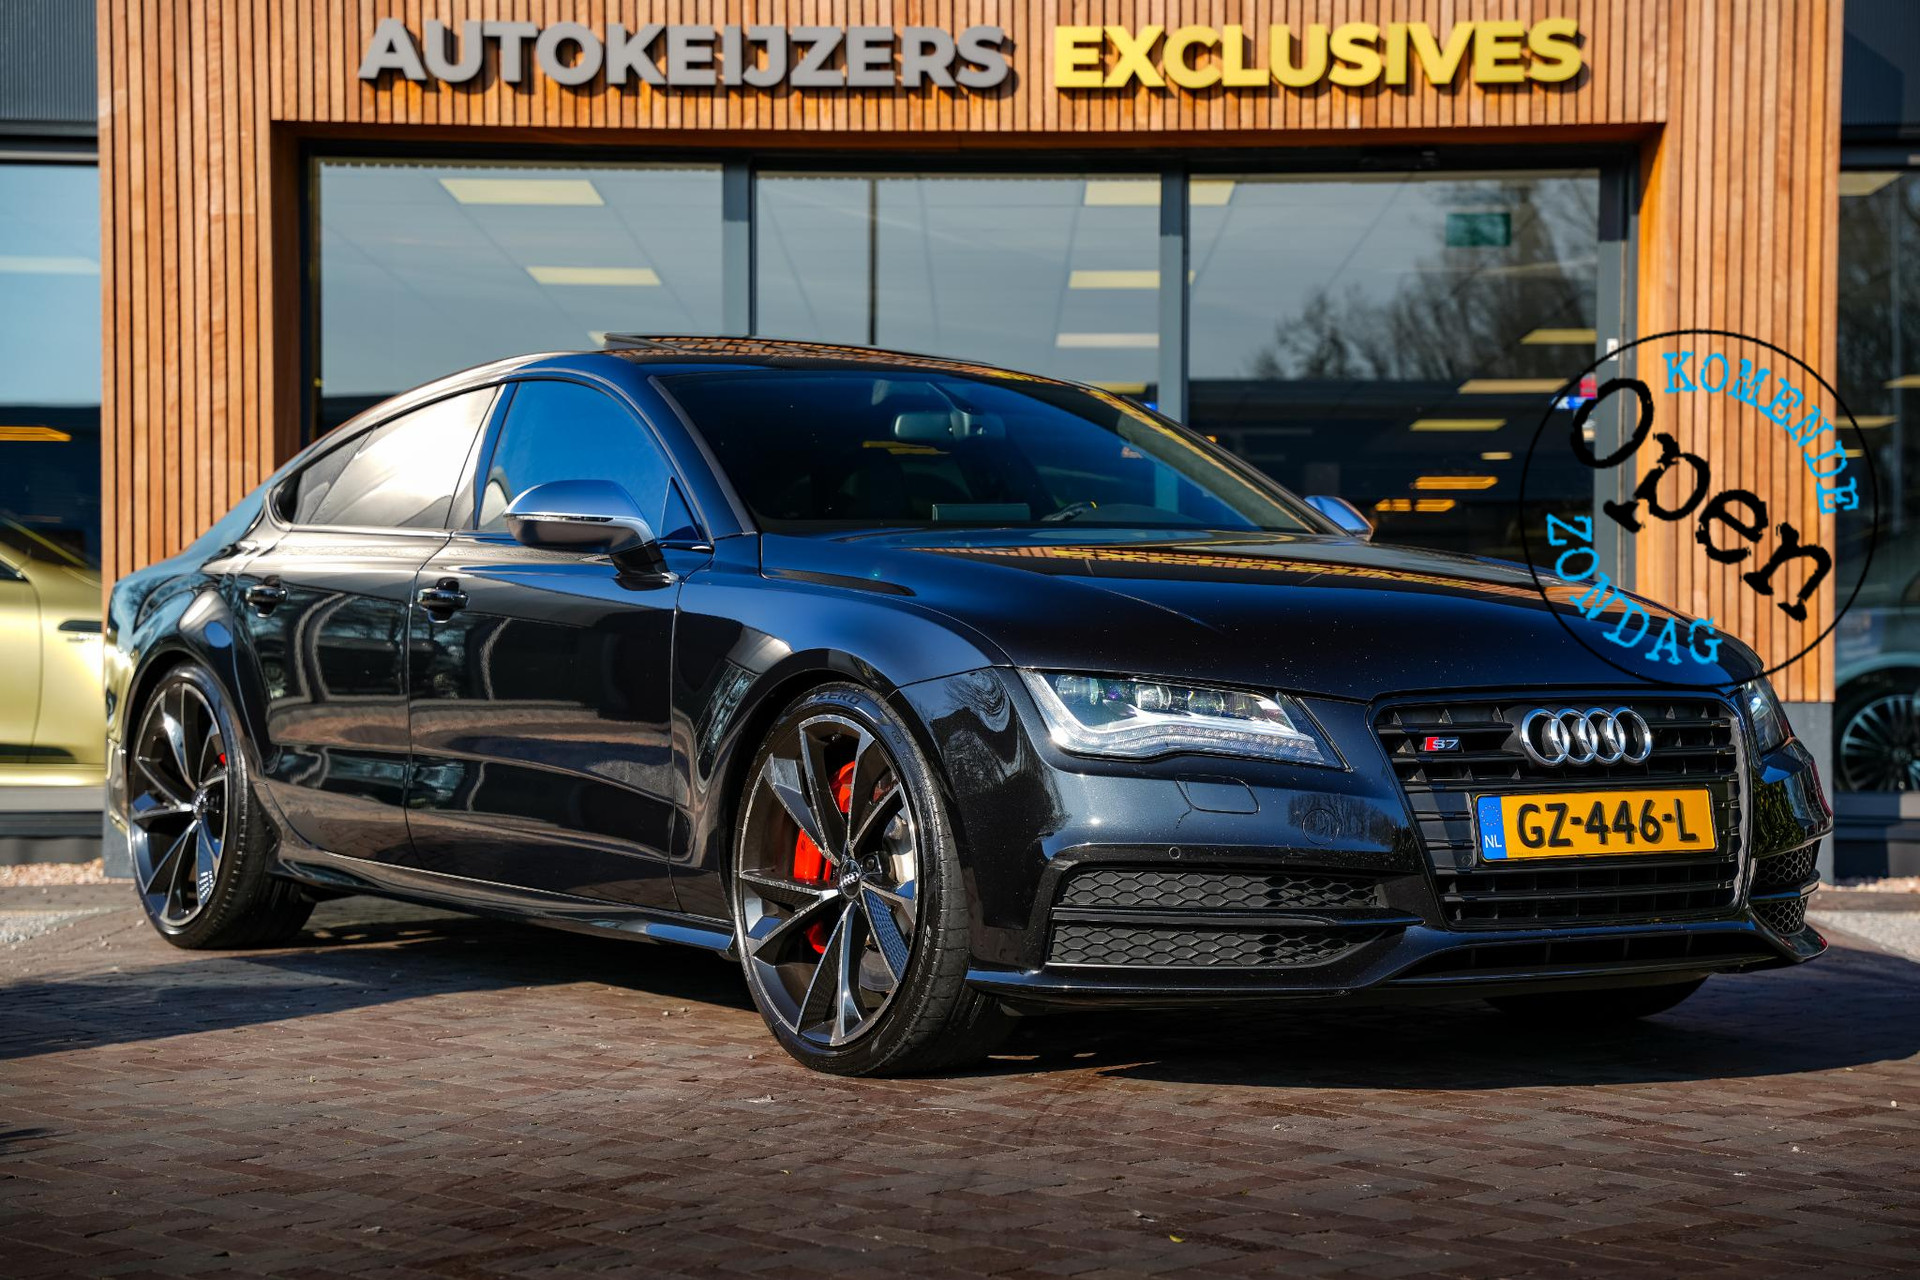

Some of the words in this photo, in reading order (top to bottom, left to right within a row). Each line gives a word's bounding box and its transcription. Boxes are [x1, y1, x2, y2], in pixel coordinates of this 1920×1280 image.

[358, 17, 1012, 88] AUTOKEIJZERS
[1053, 17, 1583, 89] EXCLUSIVES
[1432, 739, 1459, 749] S7
[1517, 798, 1701, 849] GZ-446-L
[1484, 834, 1503, 849] NL
